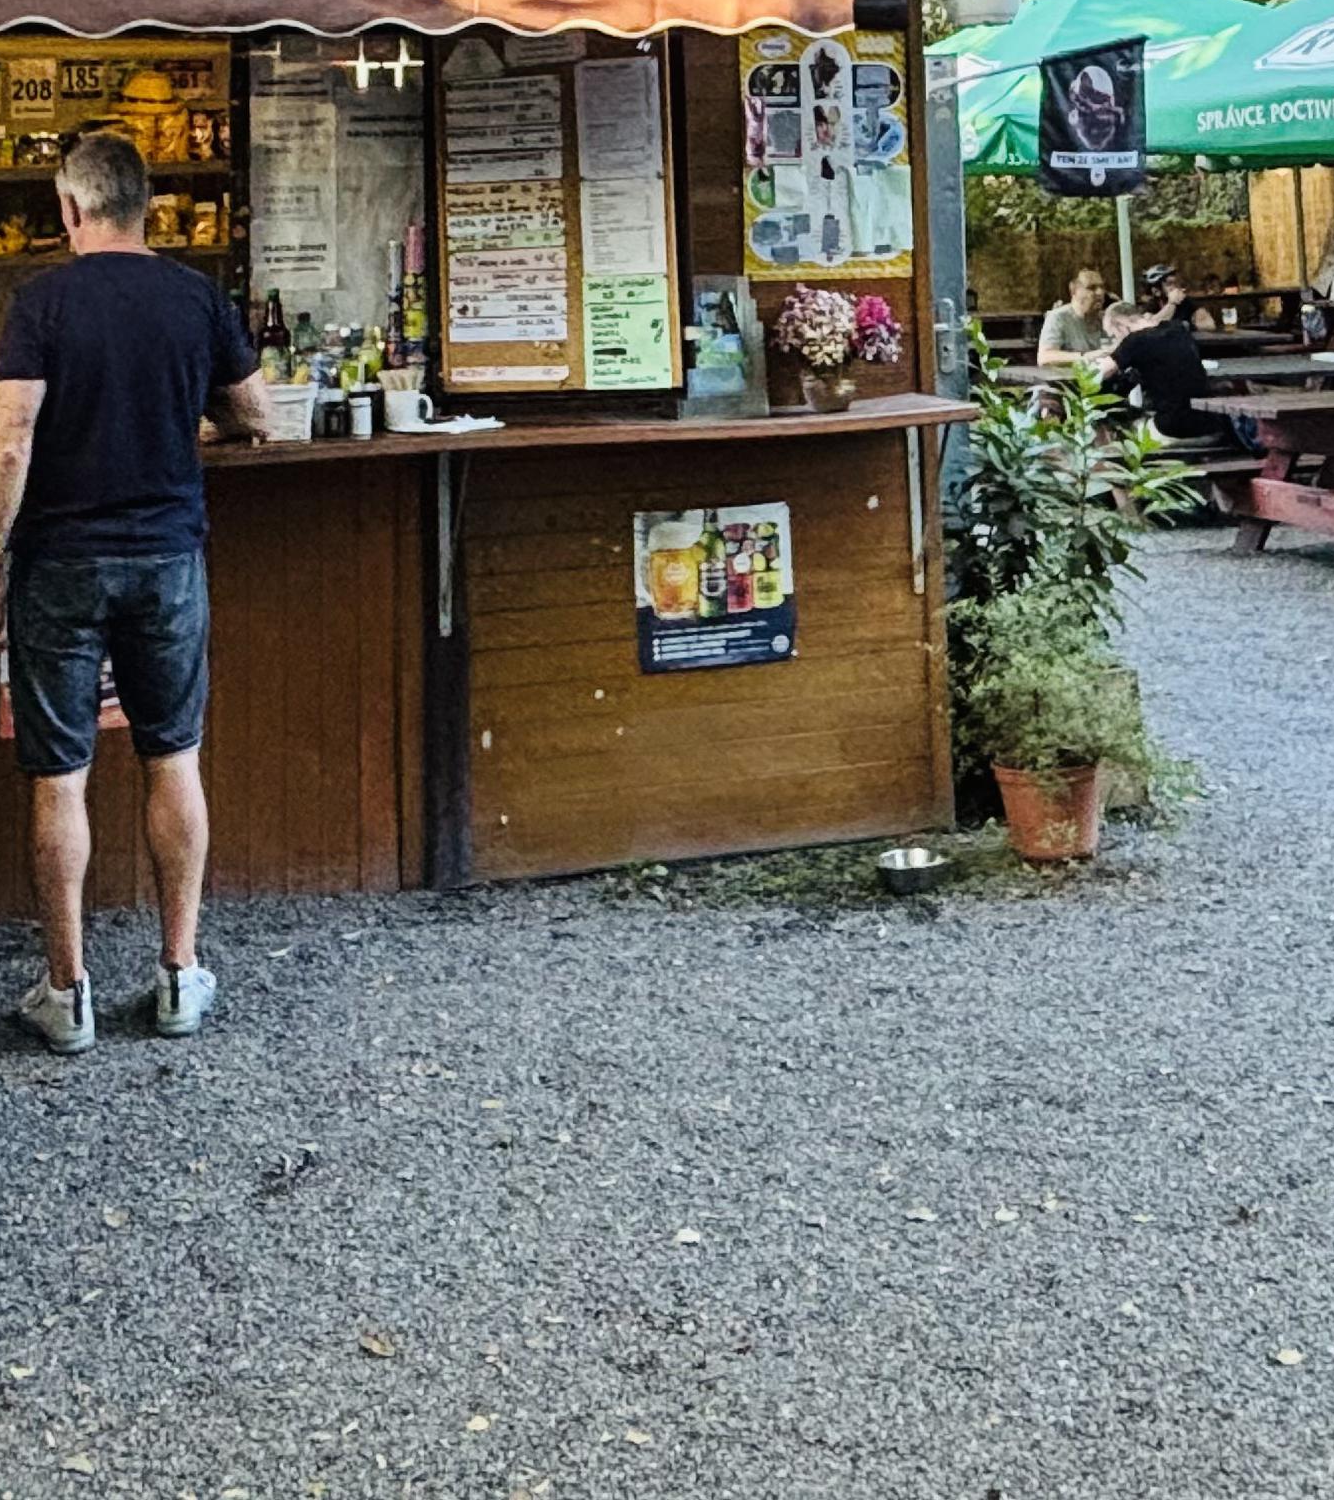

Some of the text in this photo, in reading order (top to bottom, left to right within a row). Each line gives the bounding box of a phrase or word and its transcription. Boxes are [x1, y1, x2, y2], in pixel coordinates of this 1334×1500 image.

[12, 79, 52, 100] 208
[65, 66, 100, 90] 185
[1197, 100, 1265, 132] SPRÁVCE
